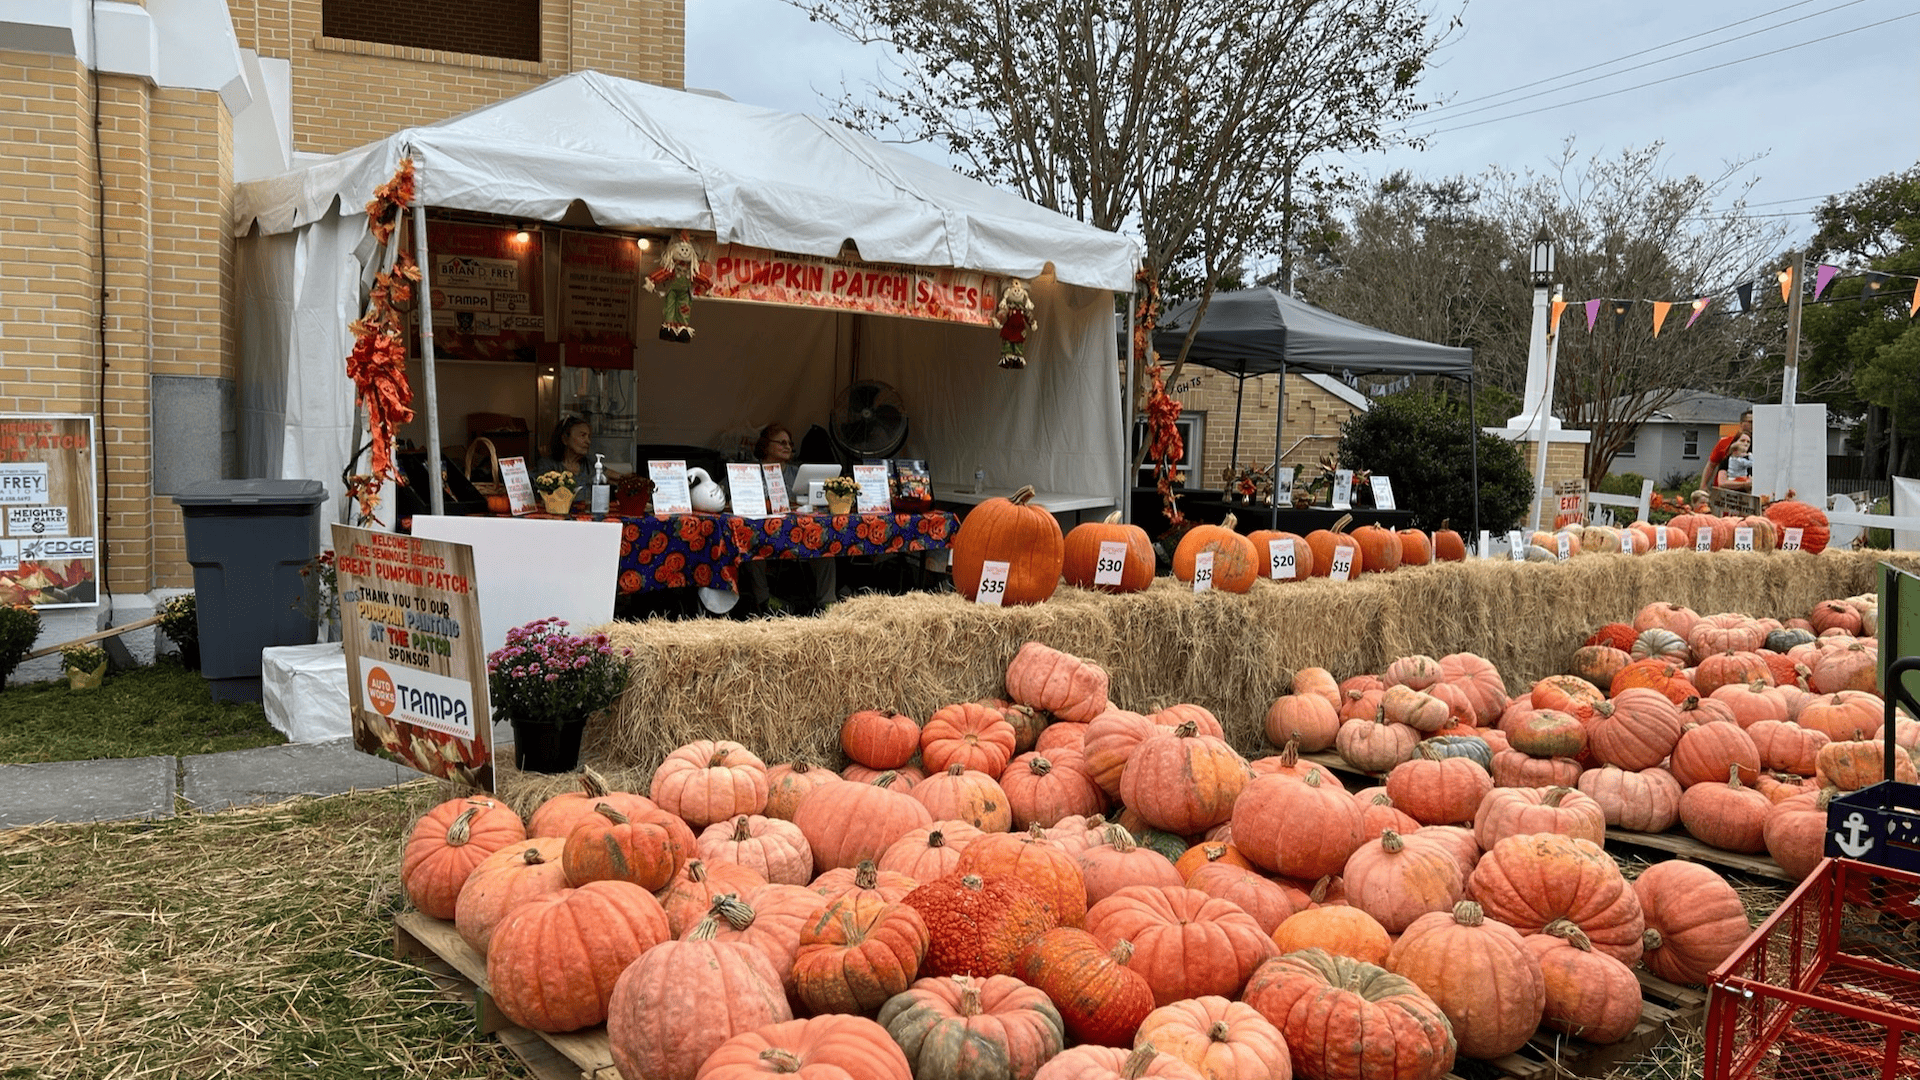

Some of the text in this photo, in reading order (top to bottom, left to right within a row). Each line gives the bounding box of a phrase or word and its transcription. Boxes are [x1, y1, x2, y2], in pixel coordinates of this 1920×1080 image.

[442, 265, 474, 276] BRIAN
[491, 269, 515, 279] FREY
[716, 256, 978, 310] PUMPKIN PATCH SALES
[447, 295, 488, 307] TAMPA
[25, 434, 86, 449] PATCH
[4, 477, 42, 489] FREY
[1561, 497, 1581, 510] EXIT
[14, 509, 63, 517] HEIGHTS
[44, 541, 94, 554] EDGE
[371, 534, 423, 552] WELCOME TO
[1697, 542, 1711, 551] $30
[1735, 543, 1751, 551] $35
[1783, 542, 1799, 551] $37
[355, 545, 445, 570] THE SEMINOLE HEIGHTS
[1098, 557, 1123, 573] $30
[1273, 554, 1295, 569] $20
[1332, 558, 1350, 573] $15
[339, 557, 469, 594] GREAT PUMPKIN PATCH
[1196, 568, 1212, 583] $25
[981, 578, 1005, 594] $35
[343, 590, 360, 602] KIDS
[360, 586, 450, 616] THANK YOU TO OUR
[358, 602, 460, 638] PUMPKIN PAINTING
[370, 623, 452, 657] AT THE PATCH
[389, 647, 430, 668] SPONSOR
[372, 678, 391, 691] AUTO
[369, 688, 395, 703] WORKS
[397, 684, 468, 726] TAMPA
